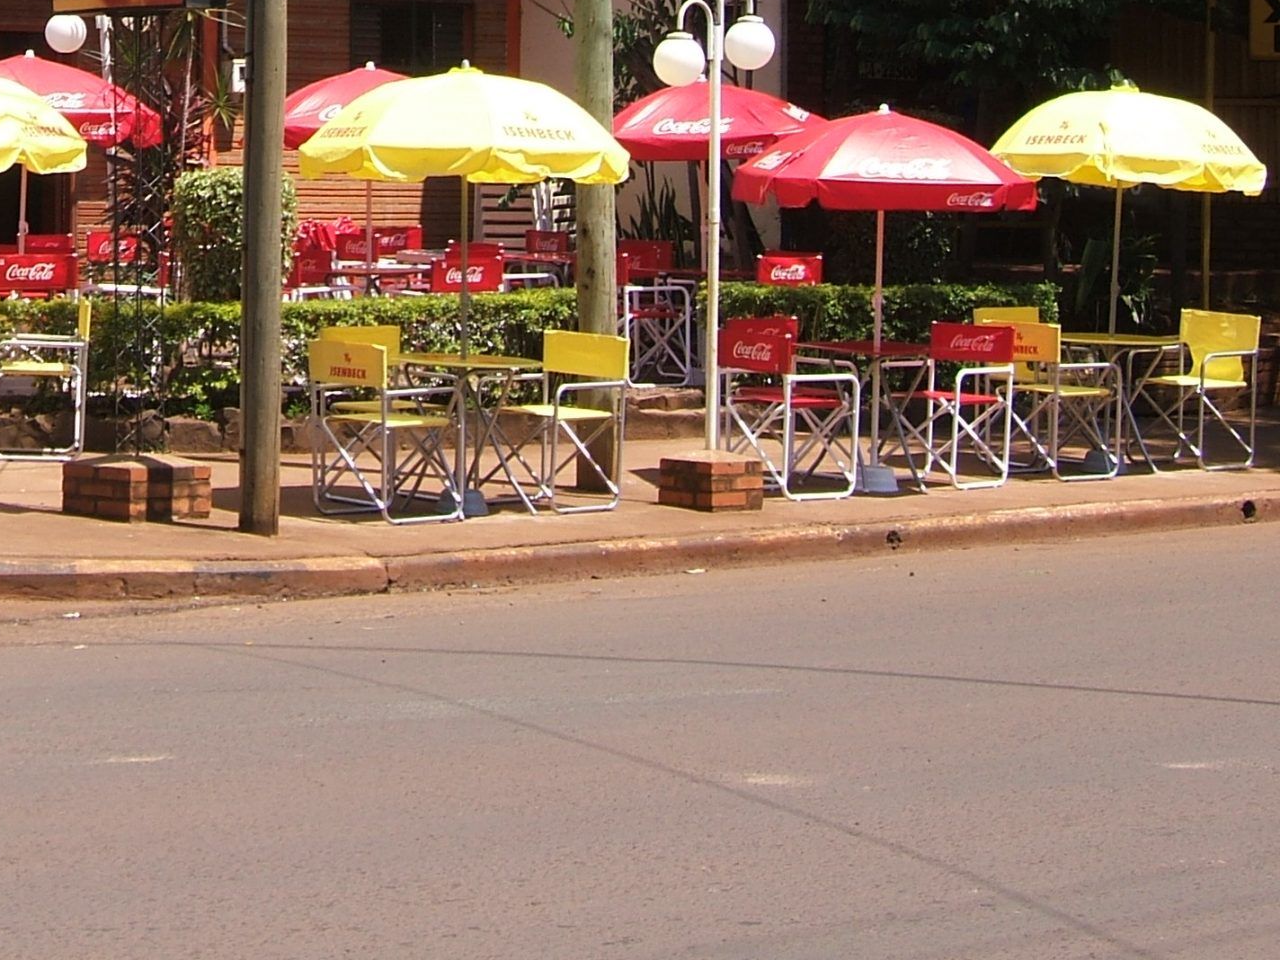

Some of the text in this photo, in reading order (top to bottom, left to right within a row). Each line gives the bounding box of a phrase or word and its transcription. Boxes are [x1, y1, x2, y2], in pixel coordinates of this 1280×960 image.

[320, 126, 368, 139] ISENBECK
[501, 125, 576, 141] ISENBECK
[1025, 134, 1087, 146] ISENBECK
[329, 365, 367, 380] ISENBECK
